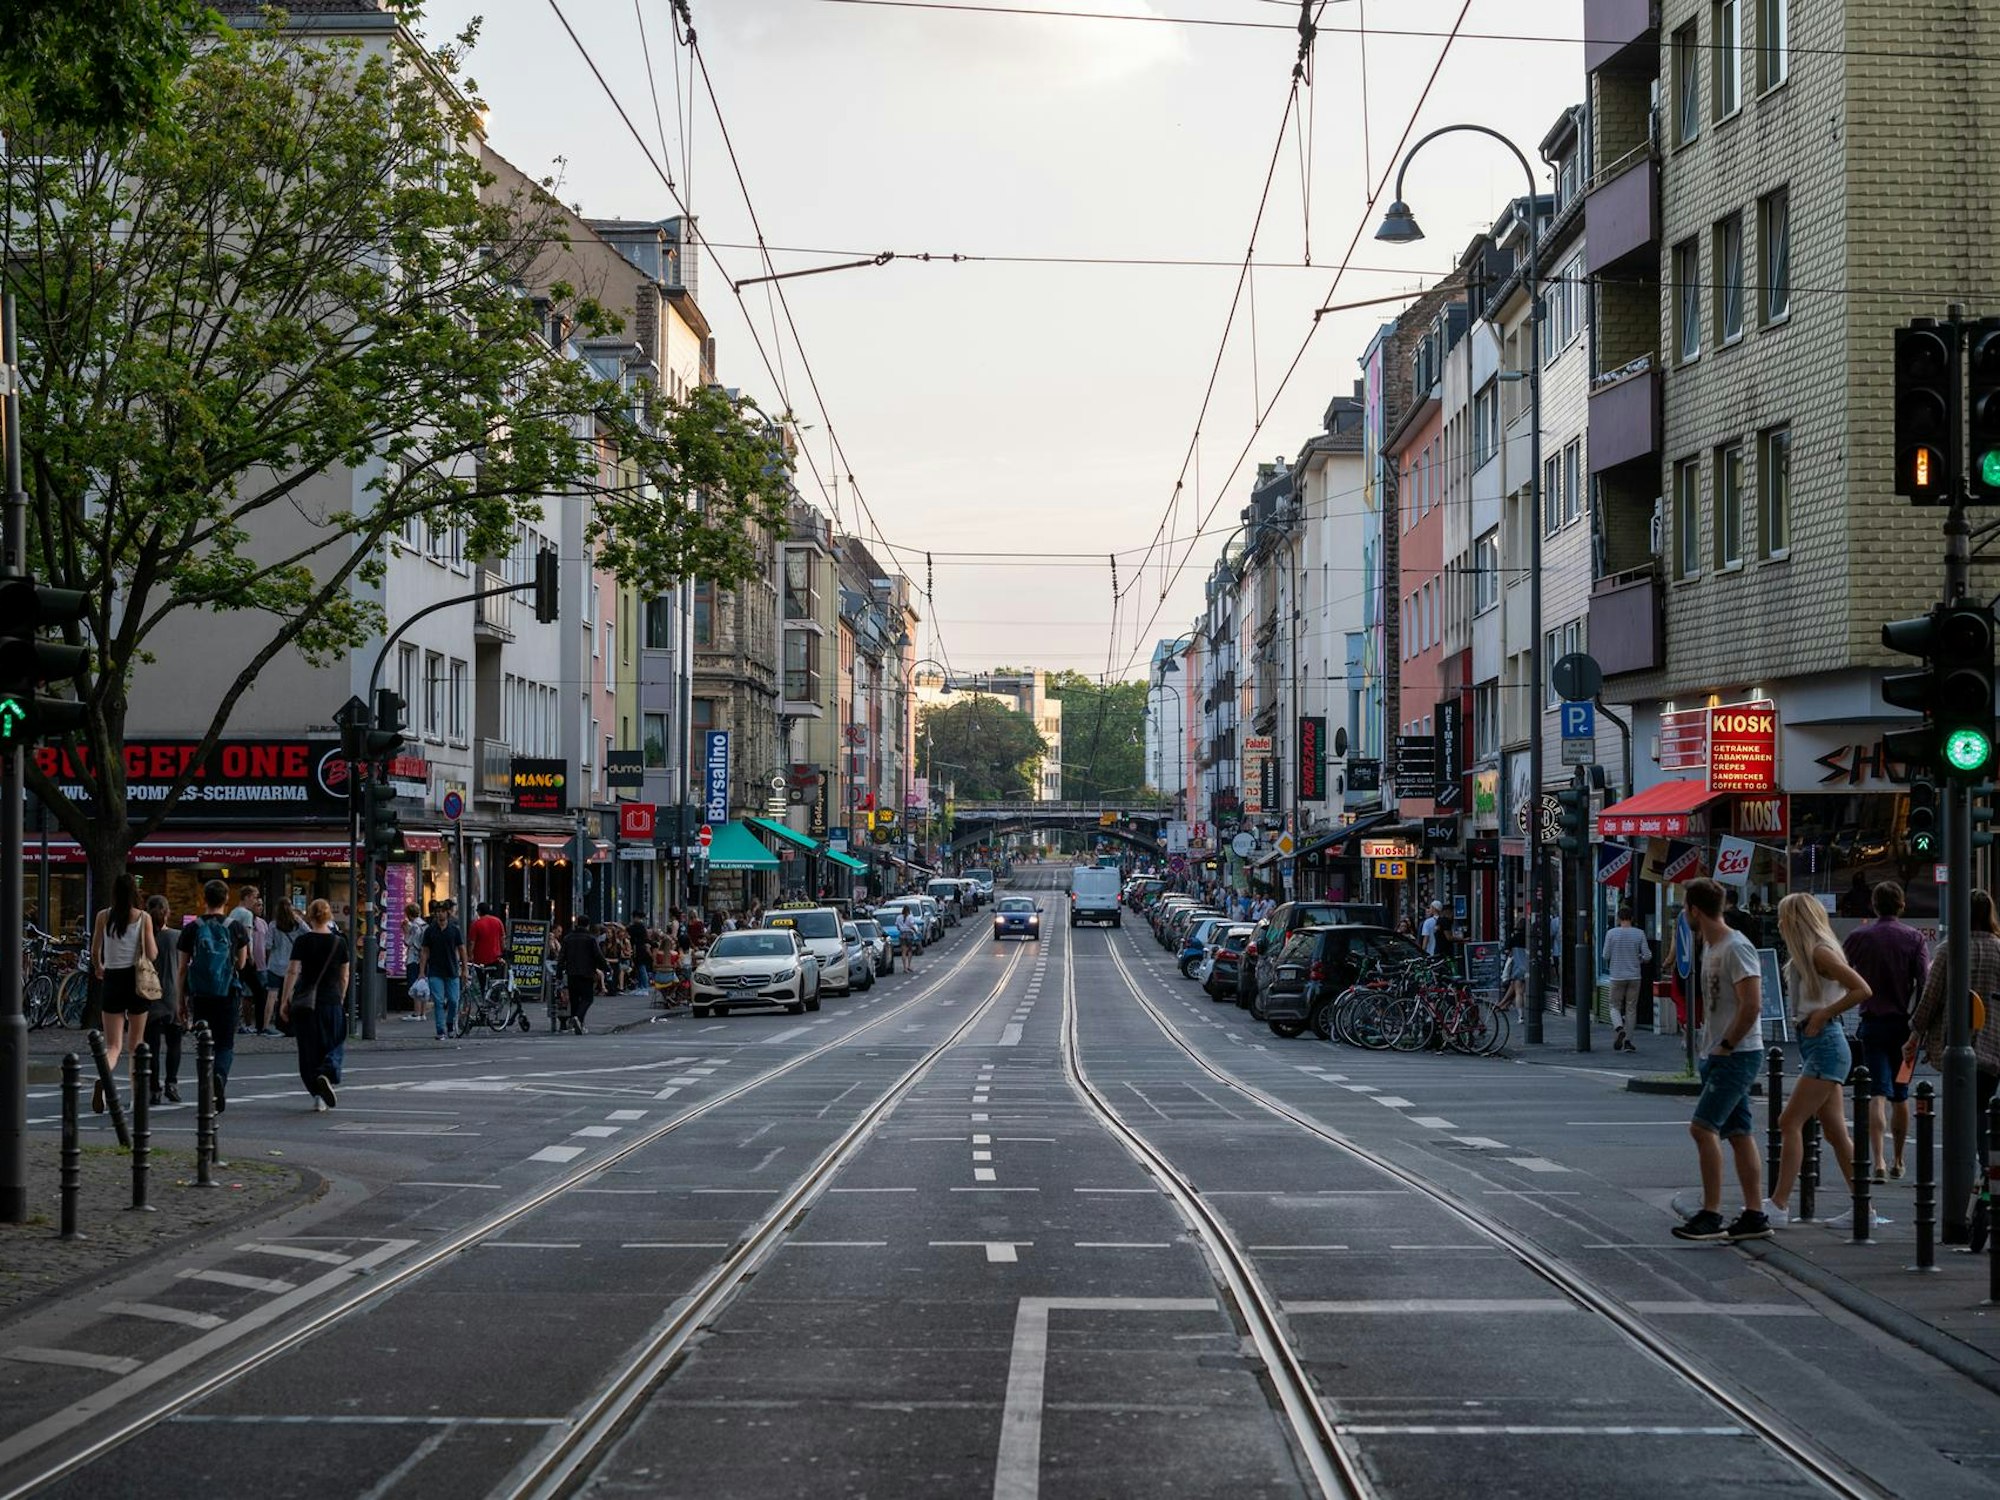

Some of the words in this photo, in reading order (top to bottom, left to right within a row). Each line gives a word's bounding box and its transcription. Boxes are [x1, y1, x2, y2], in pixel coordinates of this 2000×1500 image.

[1568, 707, 1585, 734] P
[1713, 715, 1772, 733] KIOSK
[1245, 738, 1270, 749] Falafel
[1396, 738, 1405, 747] M
[1443, 706, 1453, 781] HEIMSPIEL
[35, 745, 208, 778] BUGER
[222, 745, 308, 778] ONE
[1303, 721, 1315, 797] RENDEZVOUS
[1397, 751, 1404, 759] T
[1713, 753, 1772, 762] TABAKWAREN
[608, 763, 643, 775] duma
[514, 773, 566, 788] MANGO
[709, 734, 727, 821] Borsalino
[1712, 773, 1764, 781] SANDWICHES
[126, 785, 308, 802] POMS-SCHAWARMA
[1756, 782, 1768, 790] GO
[1740, 800, 1782, 832] KIOSK
[1427, 824, 1454, 840] sky
[1375, 847, 1405, 855] KIOSK
[1718, 849, 1749, 872] Eis
[512, 944, 543, 955] HAPPY
[514, 954, 539, 965] HOUR
